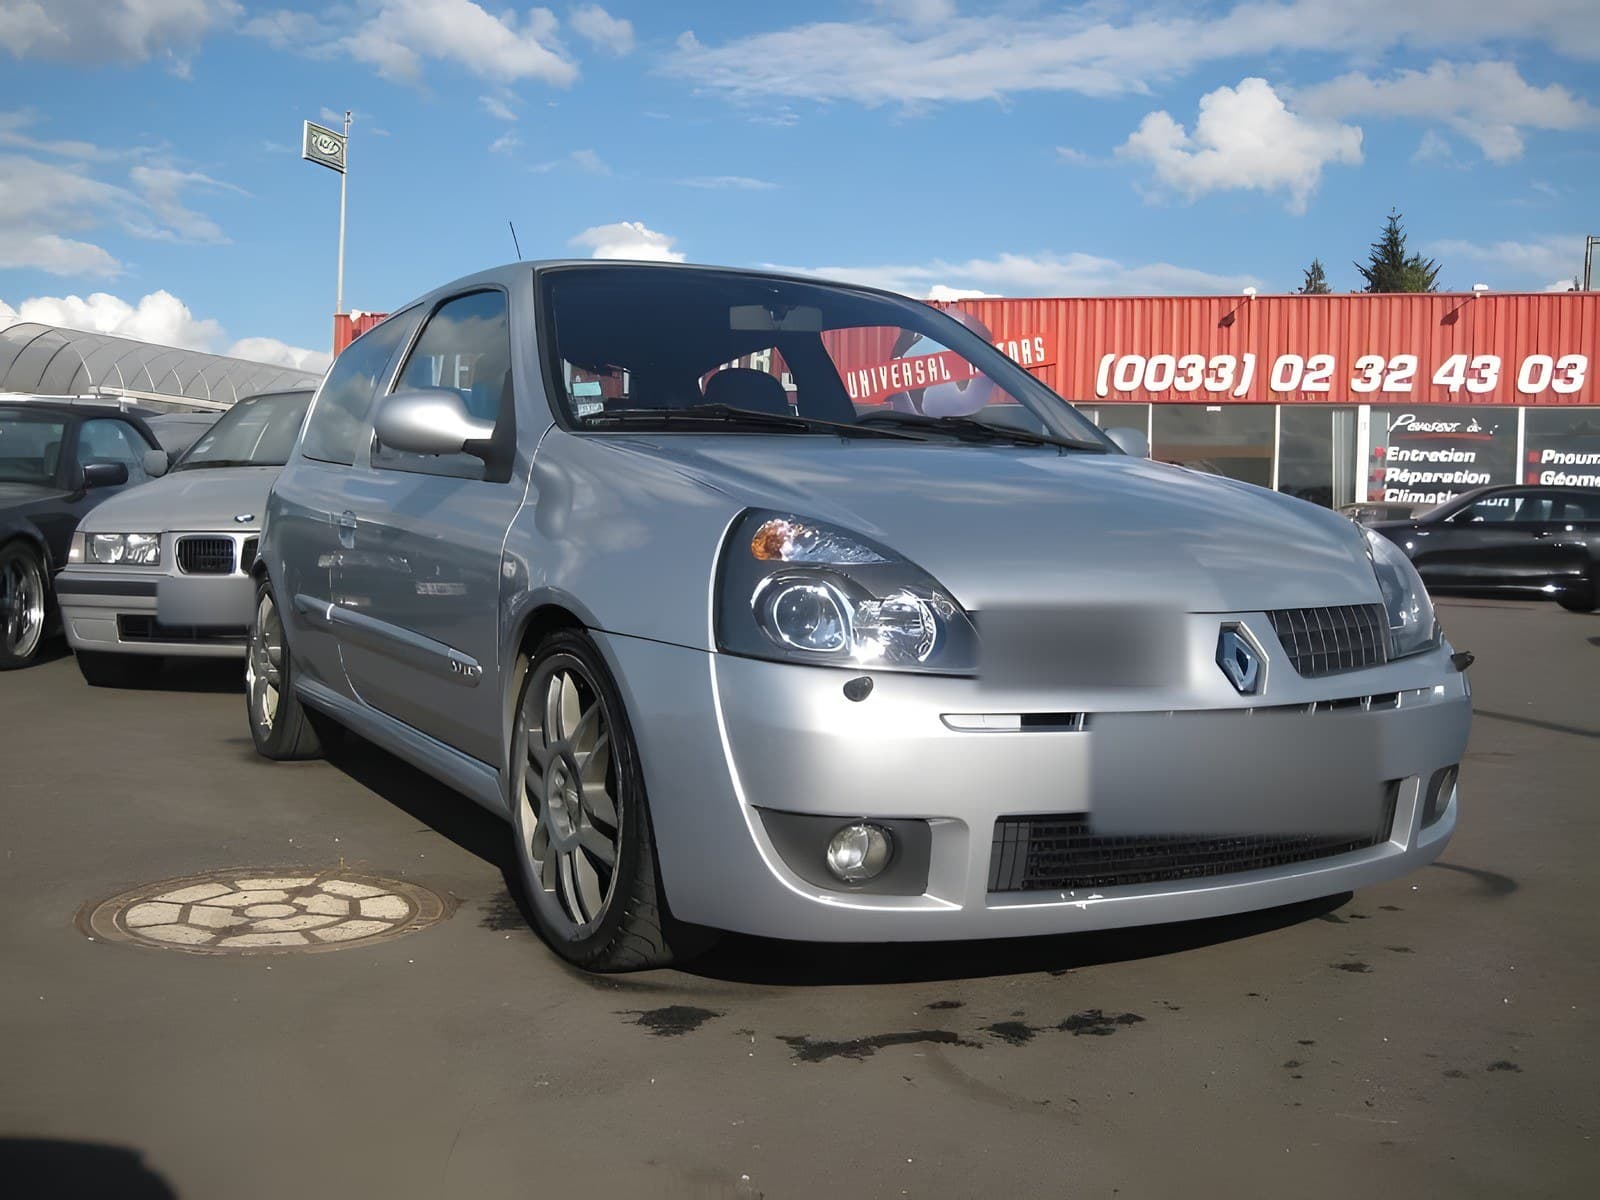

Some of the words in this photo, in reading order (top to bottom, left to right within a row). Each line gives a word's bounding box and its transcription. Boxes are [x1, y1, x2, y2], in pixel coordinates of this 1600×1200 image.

[847, 355, 951, 398] UNIVERSAL
[1097, 353, 1256, 398] (0033)
[1270, 354, 1335, 393] 02
[1351, 354, 1418, 393] 32
[1433, 354, 1502, 393] 43
[1518, 354, 1589, 394] 03
[1385, 467, 1491, 486] Réparation
